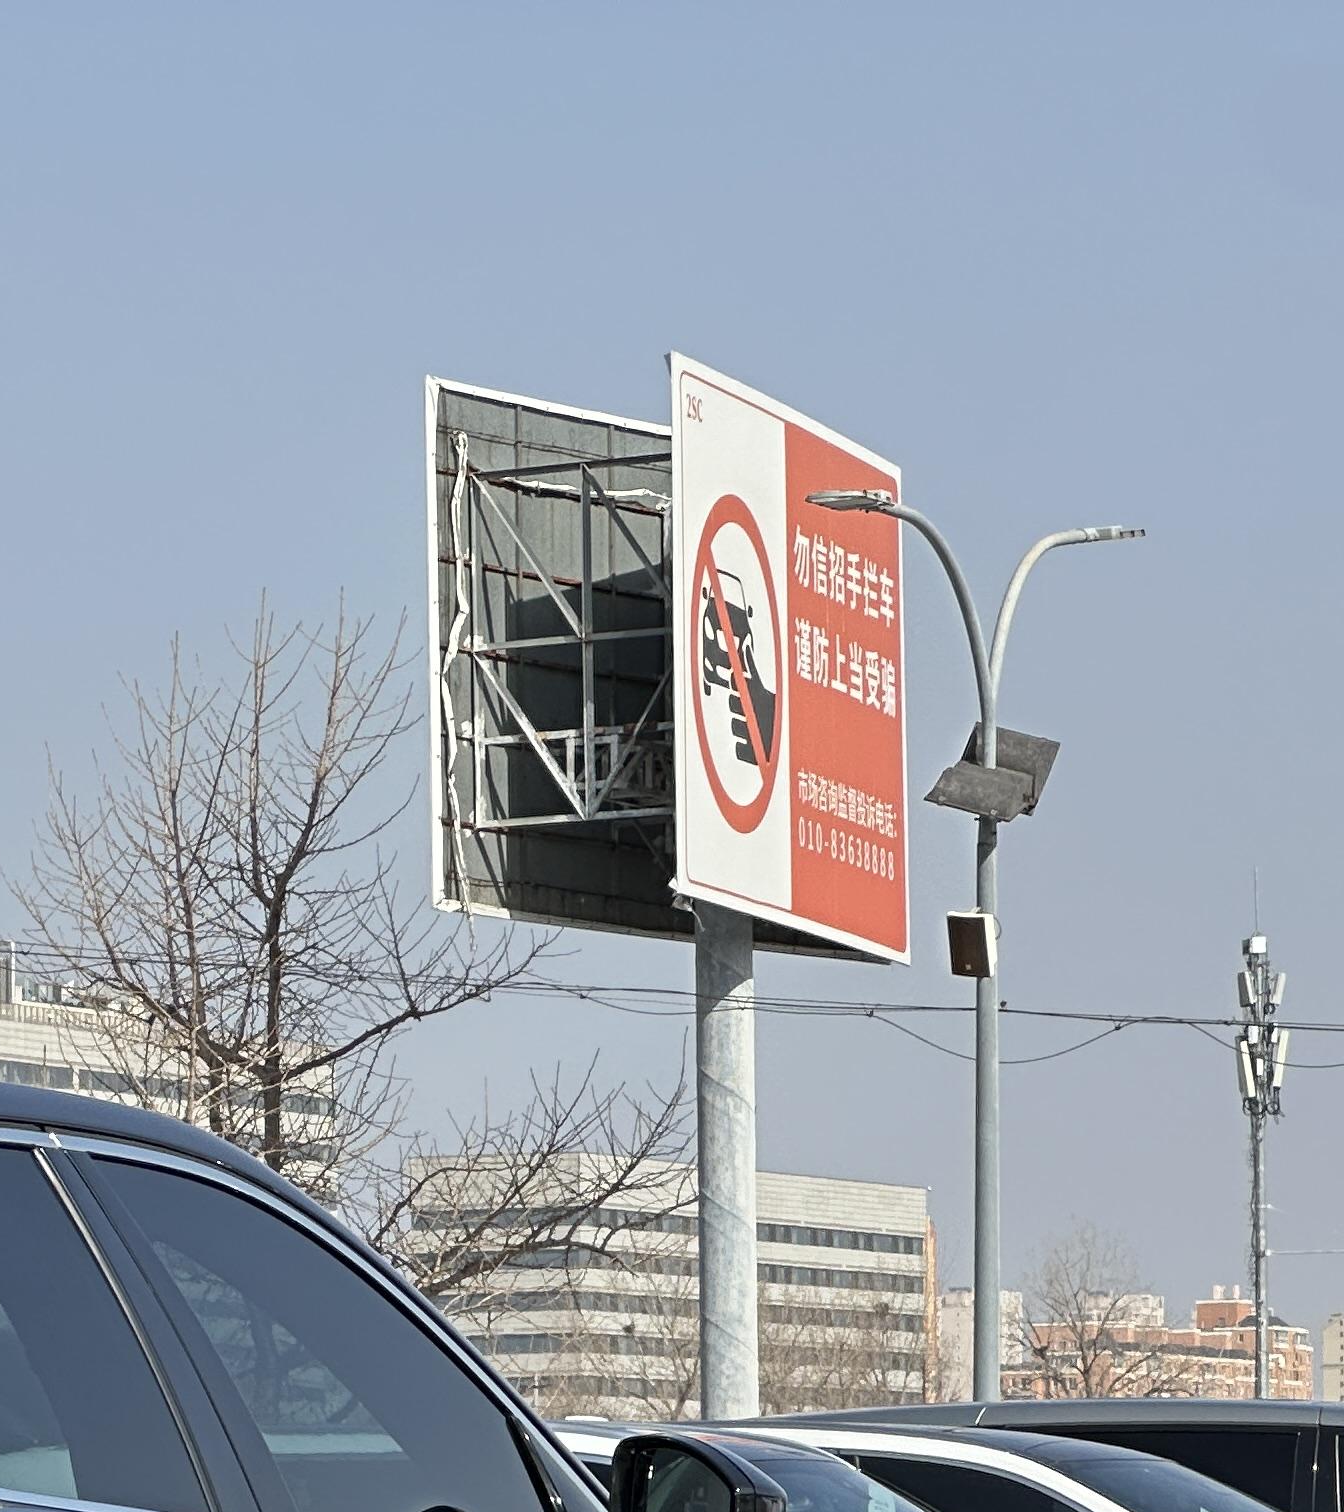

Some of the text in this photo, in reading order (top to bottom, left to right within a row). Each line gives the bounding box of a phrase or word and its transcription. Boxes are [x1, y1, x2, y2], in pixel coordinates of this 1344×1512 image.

[793, 524, 895, 628] 勿信招手拦车
[794, 616, 896, 718] 谨防上当受骗
[798, 816, 895, 880] 010-83638888
